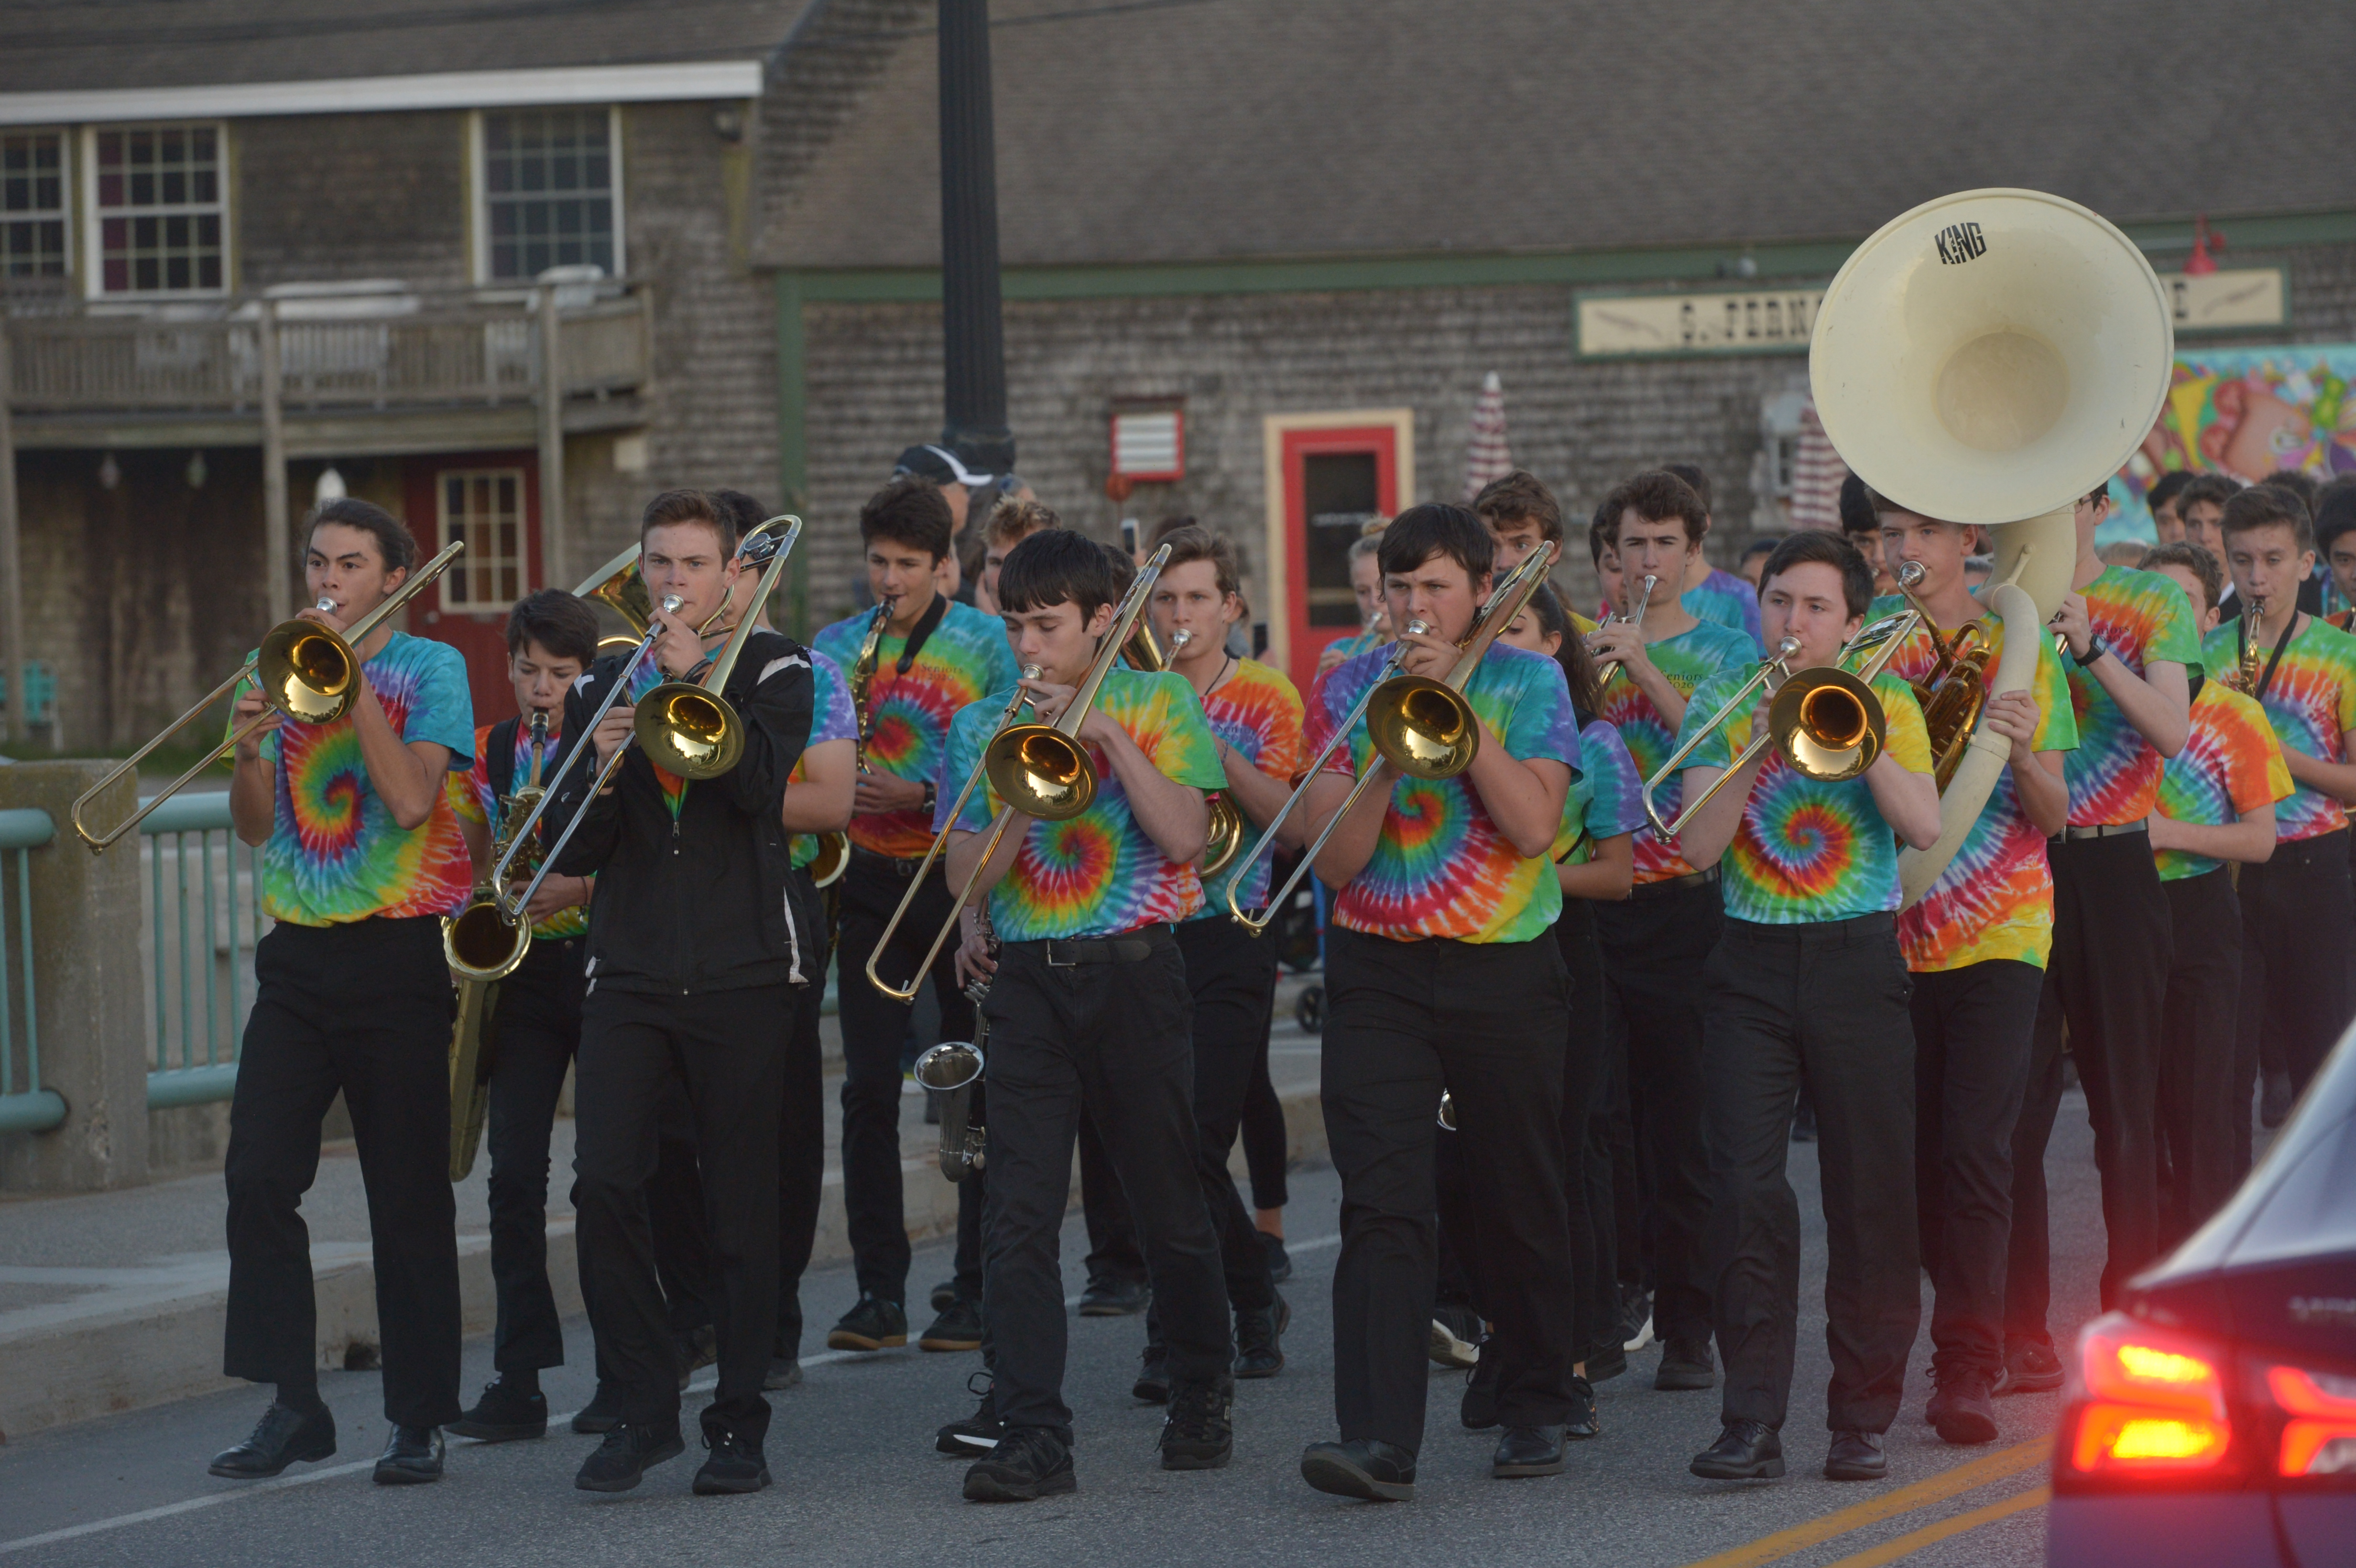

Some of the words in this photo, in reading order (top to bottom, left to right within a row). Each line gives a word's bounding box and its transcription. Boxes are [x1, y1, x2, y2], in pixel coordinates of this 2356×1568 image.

[1934, 222, 1987, 264] KING
[2090, 624, 2129, 634] eniors
[1216, 723, 1256, 735] Senior
